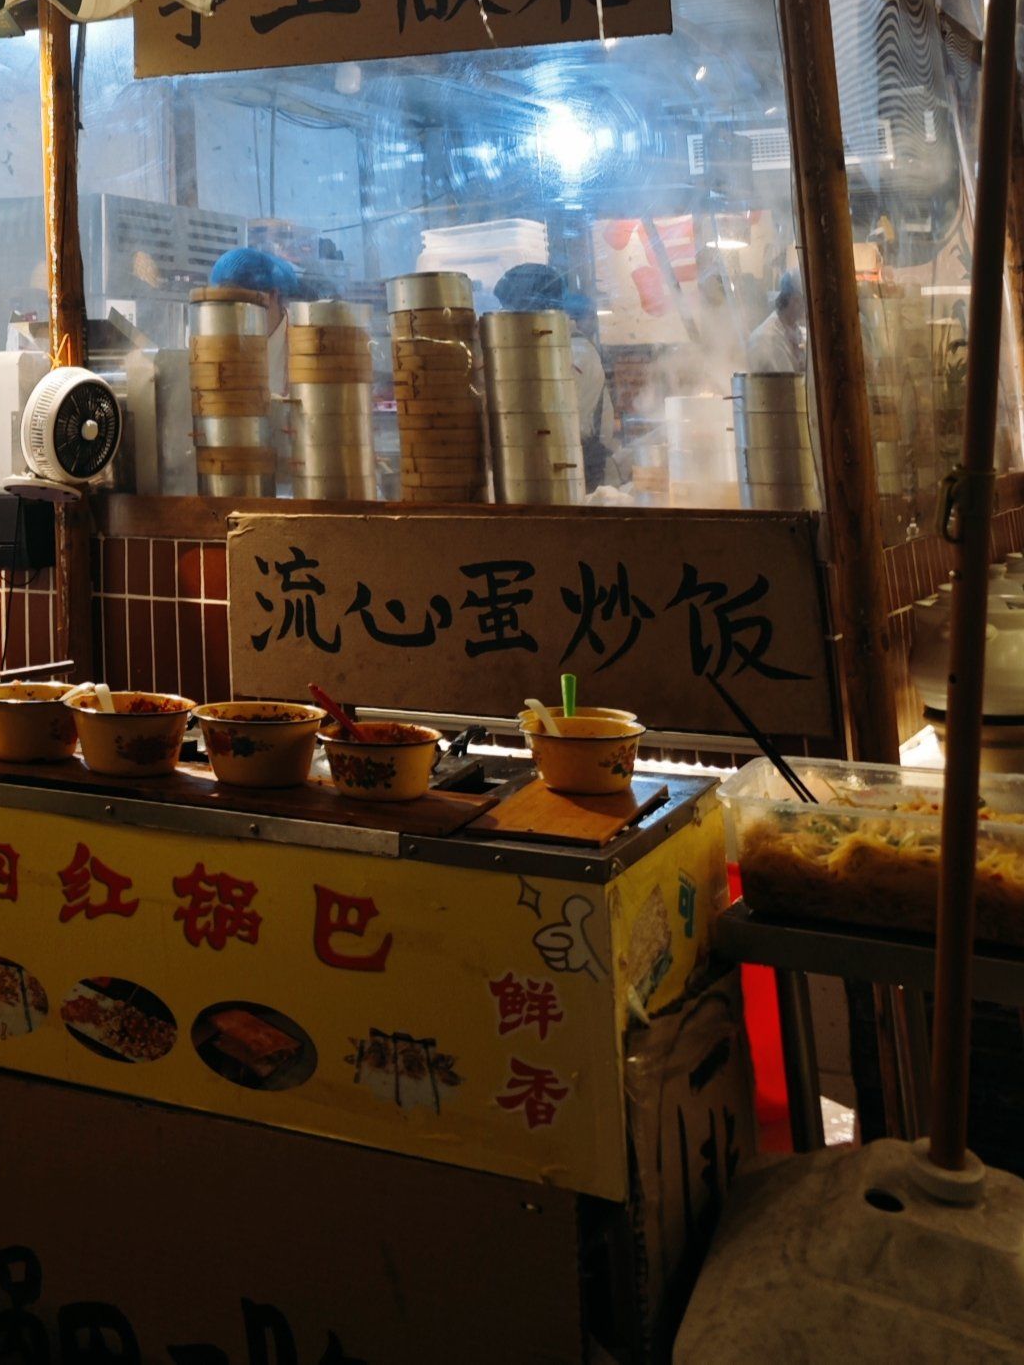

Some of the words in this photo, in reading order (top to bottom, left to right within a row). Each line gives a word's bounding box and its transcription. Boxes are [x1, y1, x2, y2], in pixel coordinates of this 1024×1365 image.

[249, 546, 814, 681] 流心蛋炒饭
[487, 970, 569, 1131] 鲜香
